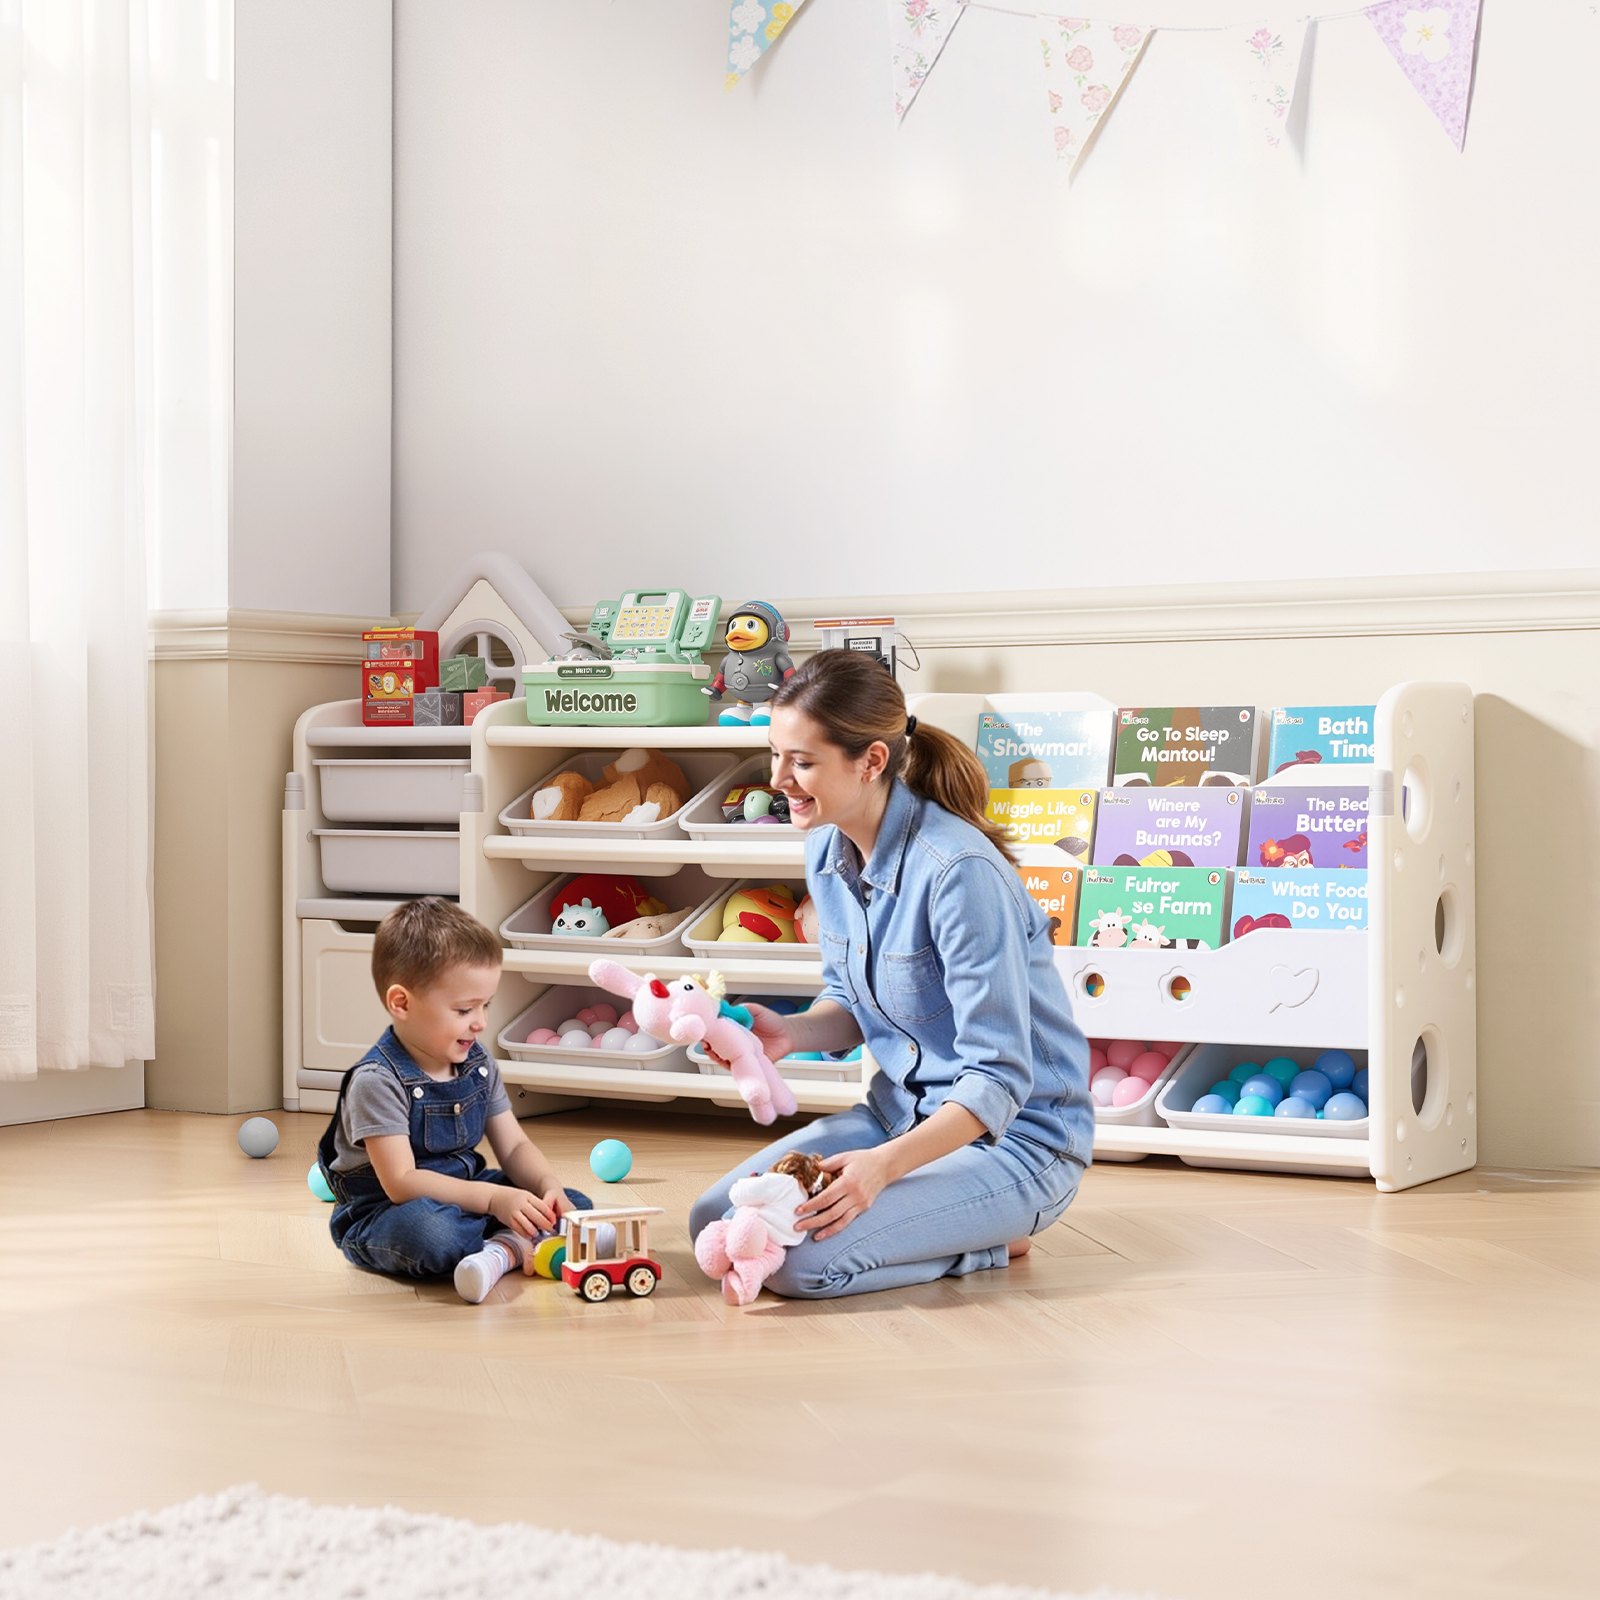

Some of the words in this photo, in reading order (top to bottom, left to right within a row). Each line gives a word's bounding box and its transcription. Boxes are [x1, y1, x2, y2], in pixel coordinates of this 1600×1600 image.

[545, 689, 637, 713] Welcome
[1014, 723, 1043, 737] The
[1318, 717, 1368, 735] Bath
[1136, 727, 1159, 742] Go
[1163, 727, 1182, 742] To
[1185, 726, 1230, 745] Sleep
[1141, 746, 1216, 762] Mantou!
[993, 801, 1043, 818] Wiggle
[1047, 801, 1077, 815] Like
[1306, 797, 1335, 811] The
[1339, 797, 1369, 811] Bed
[997, 819, 1062, 840] ogua!
[1155, 818, 1180, 828] are
[1184, 815, 1208, 832] My
[1296, 813, 1368, 833] Butter
[1026, 876, 1049, 890] Me
[1271, 880, 1320, 897] What
[1325, 882, 1368, 898] Food
[1034, 895, 1066, 914] ge!
[1159, 896, 1212, 915] Farm
[1292, 901, 1320, 919] Do
[1326, 902, 1363, 920] You
